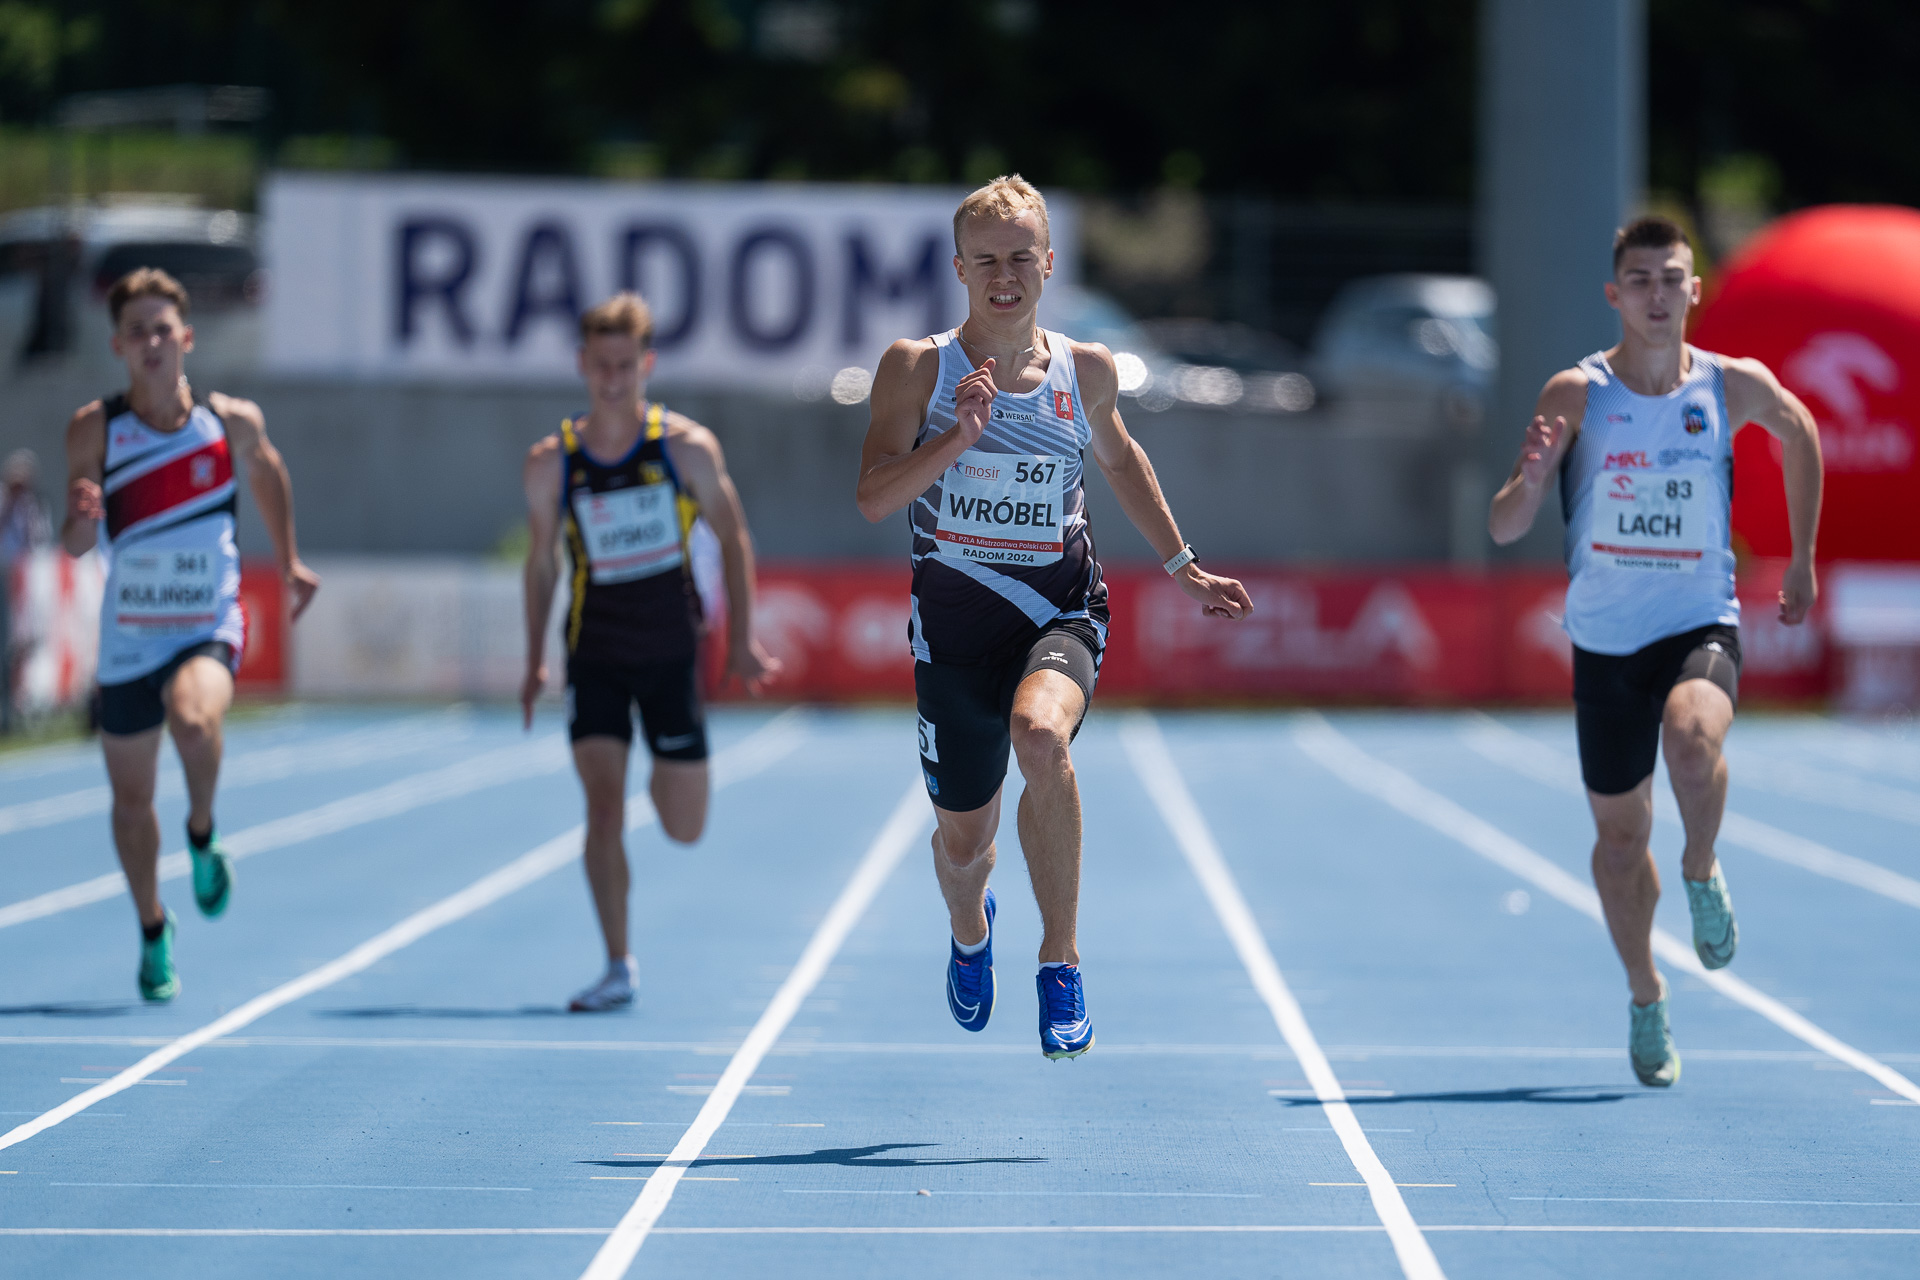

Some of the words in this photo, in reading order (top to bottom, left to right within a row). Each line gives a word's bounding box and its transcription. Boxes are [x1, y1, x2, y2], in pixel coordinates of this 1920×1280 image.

[392, 217, 950, 347] RADOM
[1006, 413, 1033, 421] WERSAL
[1604, 451, 1652, 470] MKL
[965, 465, 1000, 479] mosir
[1015, 462, 1056, 484] 567
[1666, 480, 1692, 500] 83
[950, 493, 1056, 527] WRÓBEL
[1618, 513, 1682, 537] LACH
[948, 533, 957, 541] 78.
[958, 535, 975, 544] PZLA
[976, 539, 1018, 549] Mistrzostwa
[963, 548, 1004, 561] RADOM
[1007, 552, 1034, 563] 2024
[918, 719, 929, 753] 5
